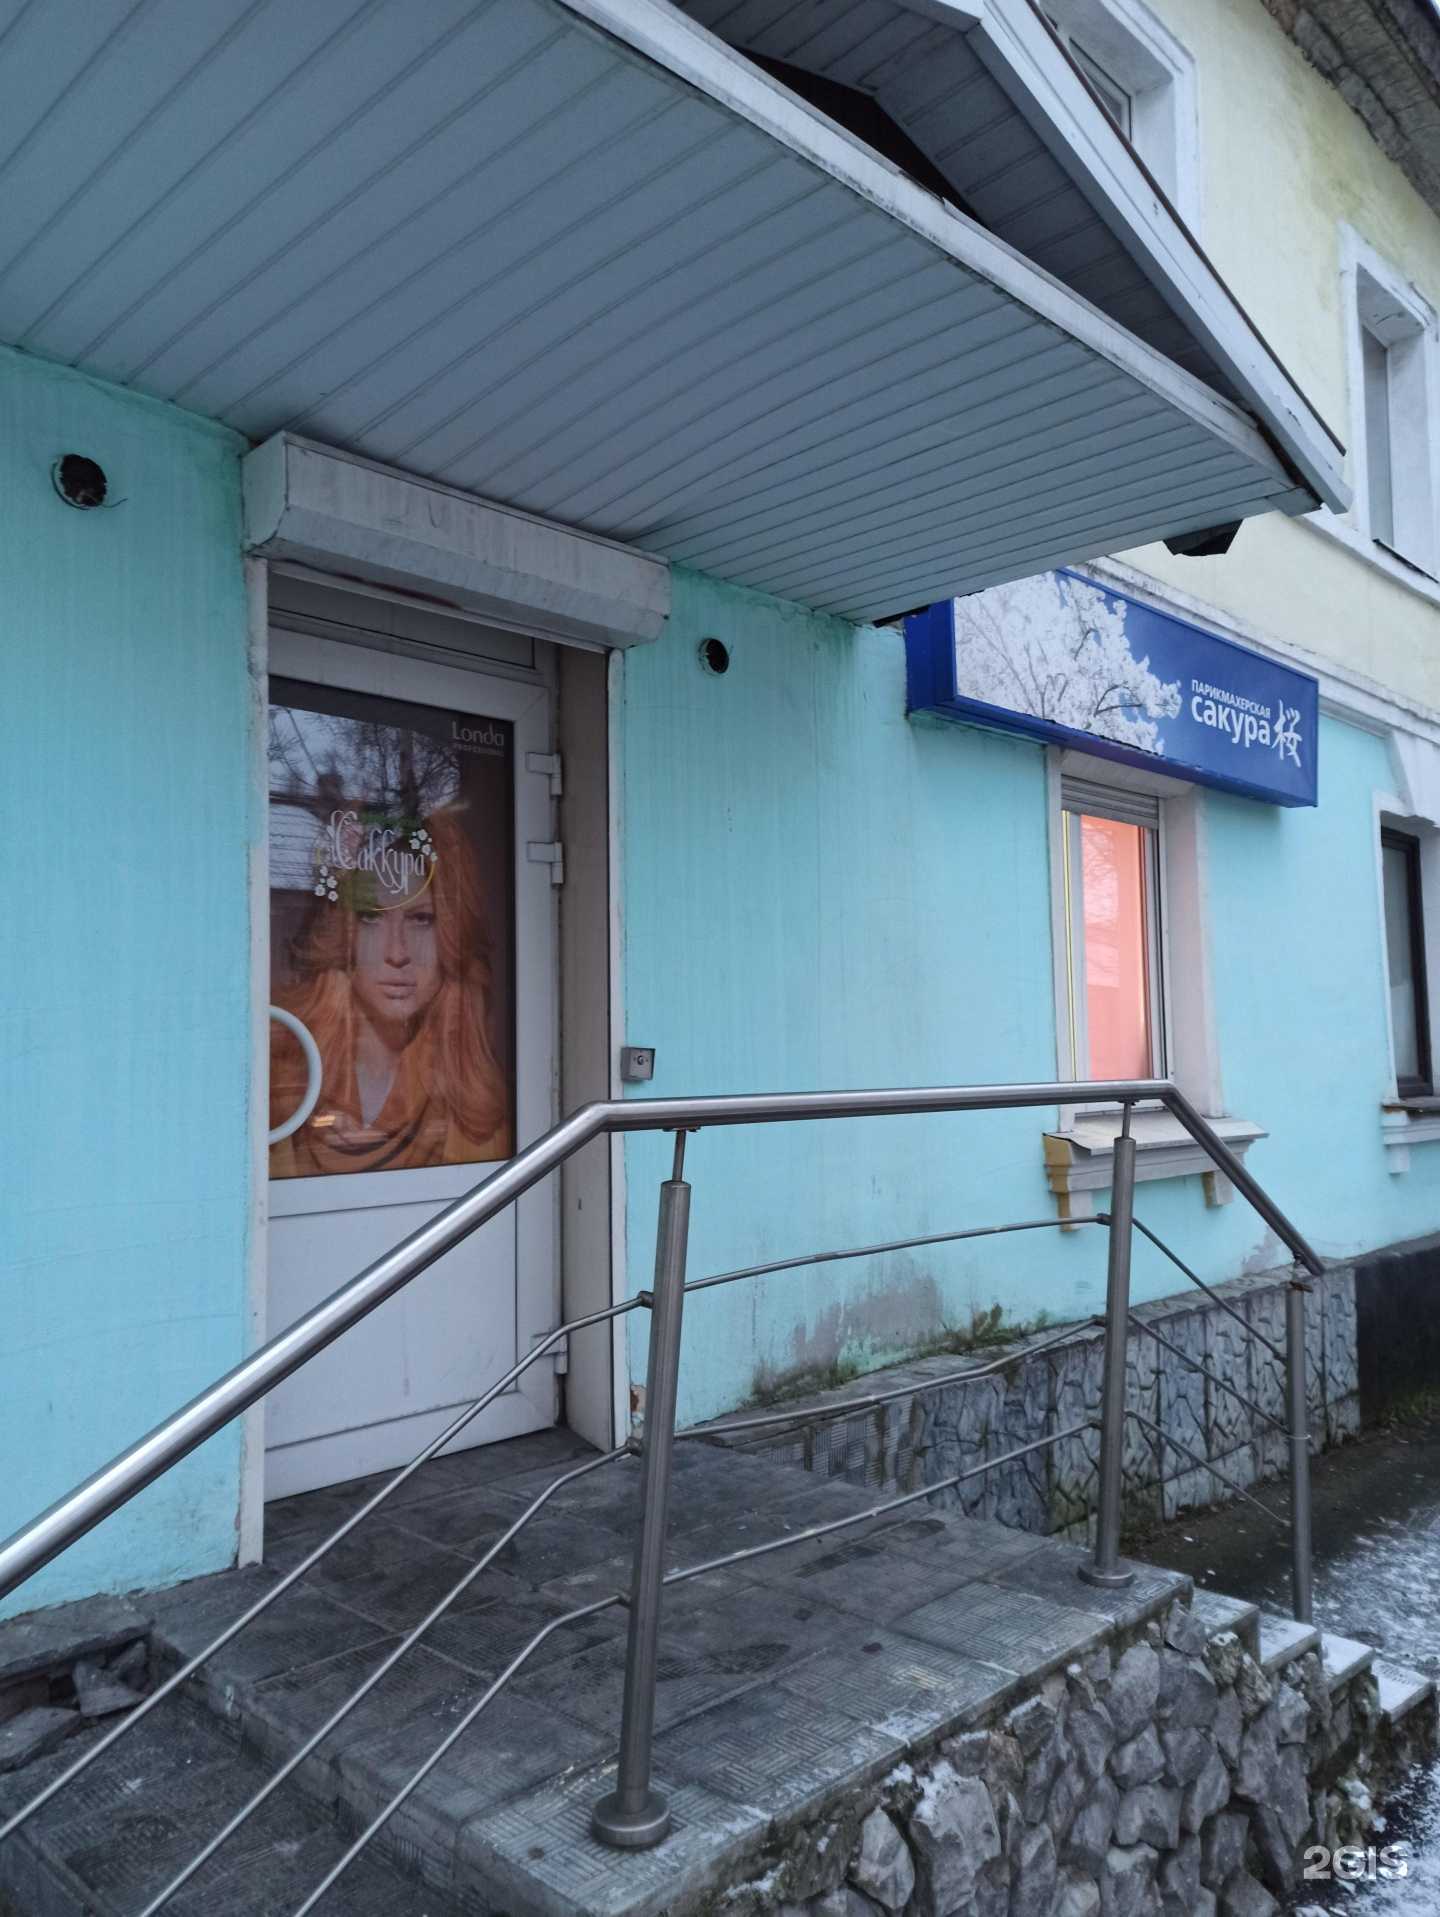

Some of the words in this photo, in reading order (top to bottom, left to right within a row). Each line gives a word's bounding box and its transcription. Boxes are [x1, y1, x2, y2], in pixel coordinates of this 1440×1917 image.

[1191, 679, 1271, 719] ПАРИКМАХЕРСКАЯ
[452, 720, 505, 746] Londa
[1191, 695, 1271, 748] сакура
